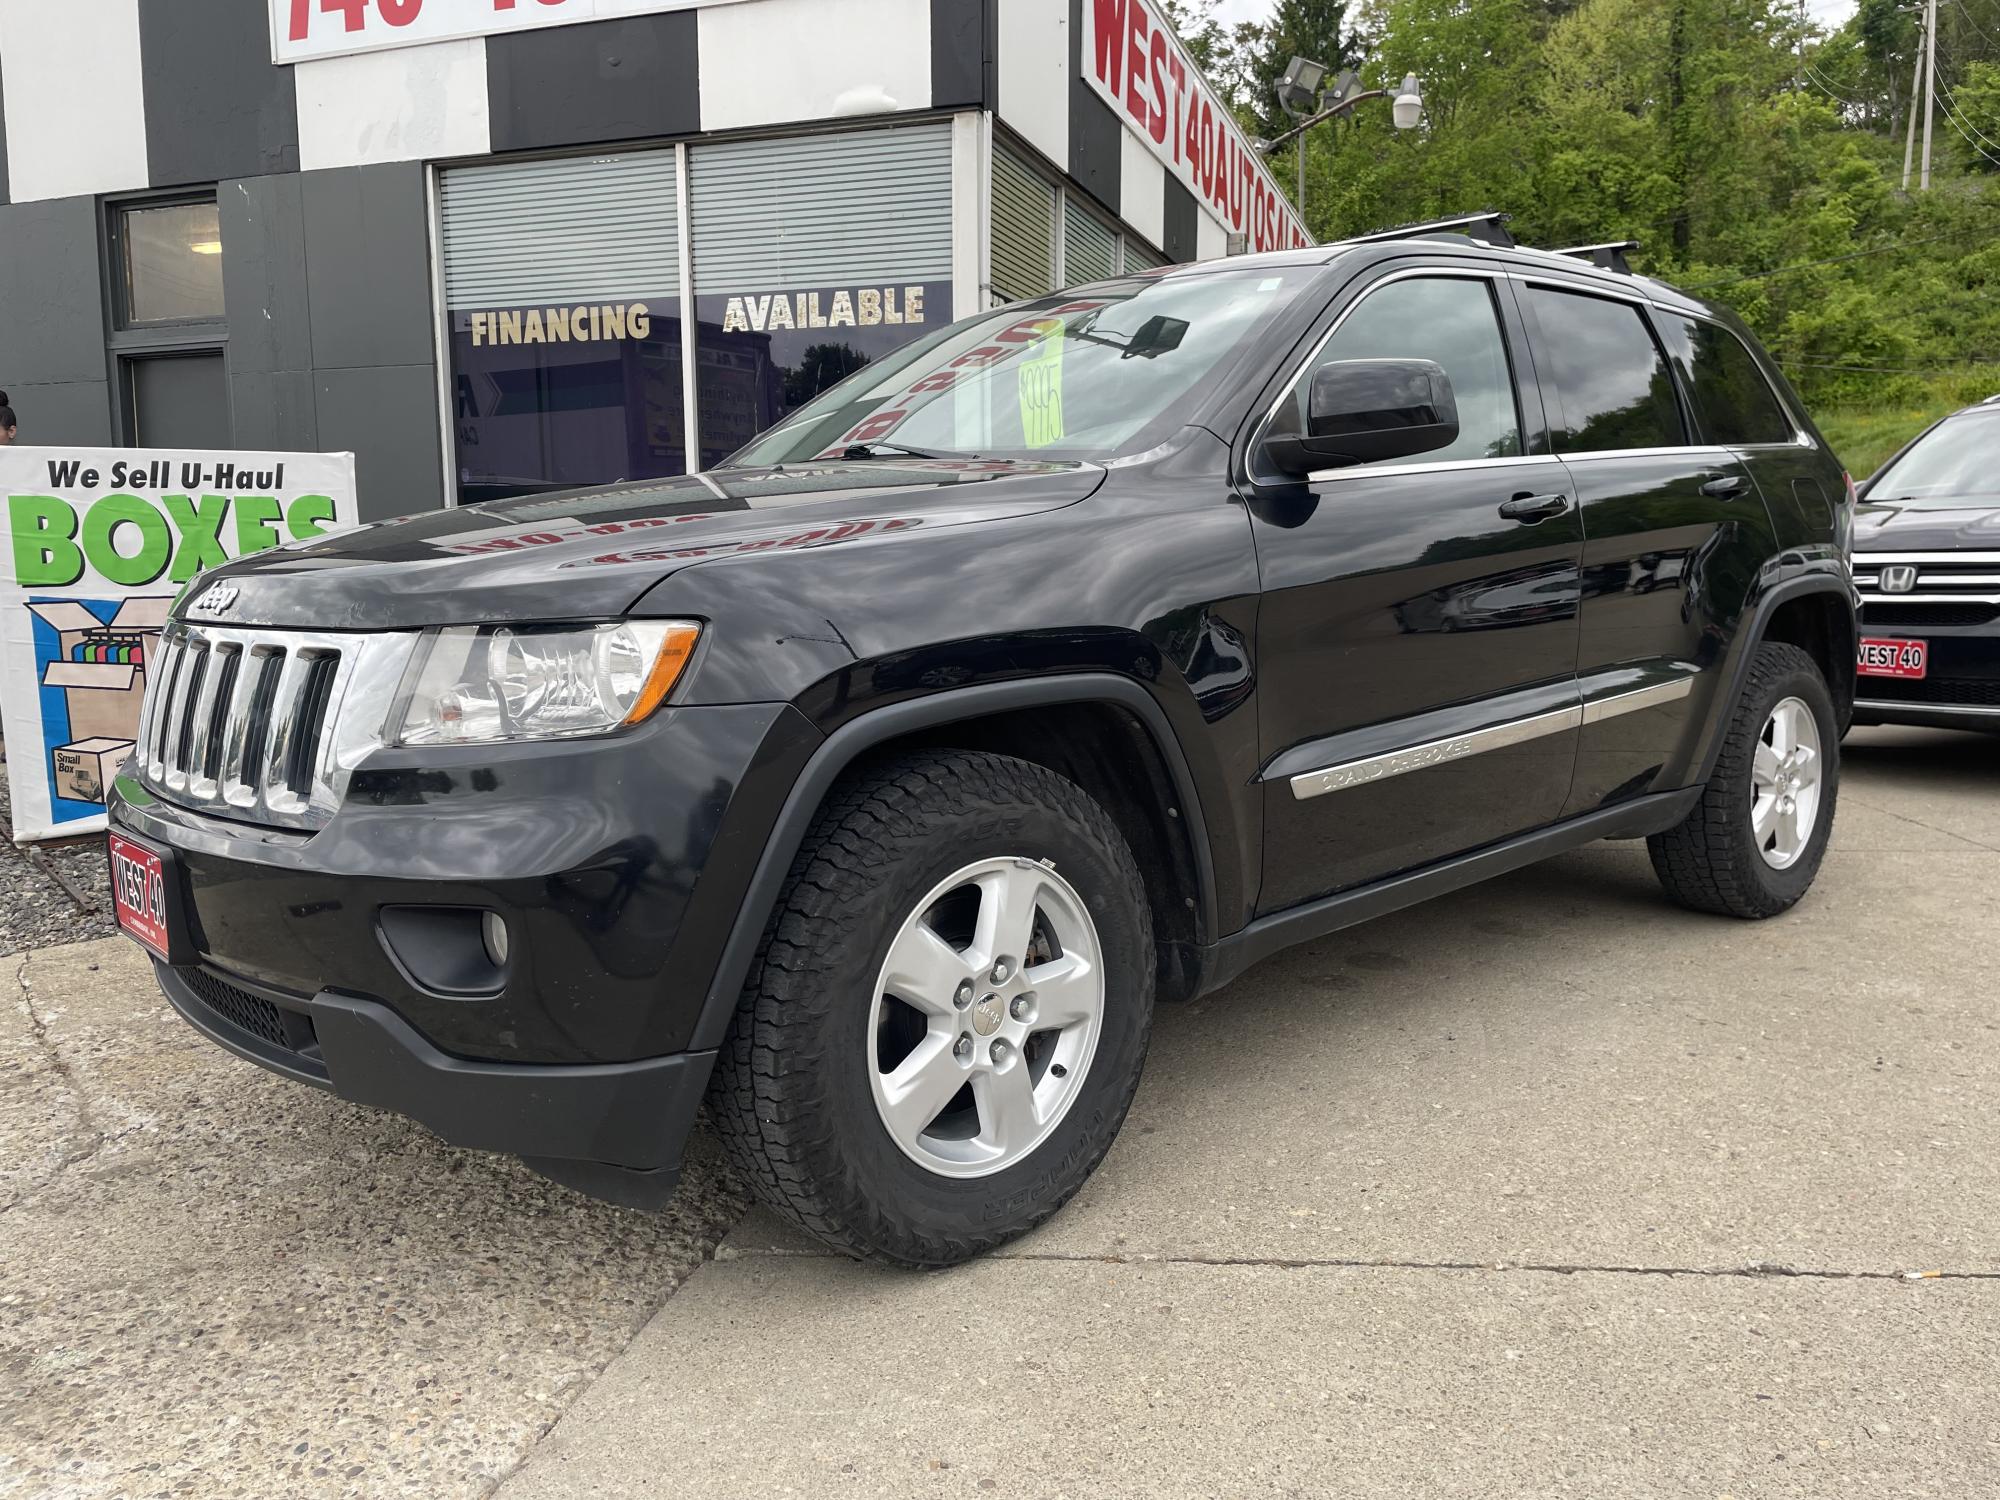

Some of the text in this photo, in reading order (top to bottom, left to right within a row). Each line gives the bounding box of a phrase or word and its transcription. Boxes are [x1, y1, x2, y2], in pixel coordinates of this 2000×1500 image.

[1093, 0, 1186, 166] WEST
[1186, 81, 1216, 200] 40
[472, 286, 924, 346] FINANCING AVAILABLE
[48, 460, 284, 490] We Sell U-Haul
[196, 580, 239, 616] Jeep
[1899, 646, 1923, 669] 40
[57, 752, 81, 765] Small
[58, 763, 74, 774] Box
[1322, 739, 1472, 791] GRAND CHEROKEE
[112, 850, 166, 930] WEST 40
